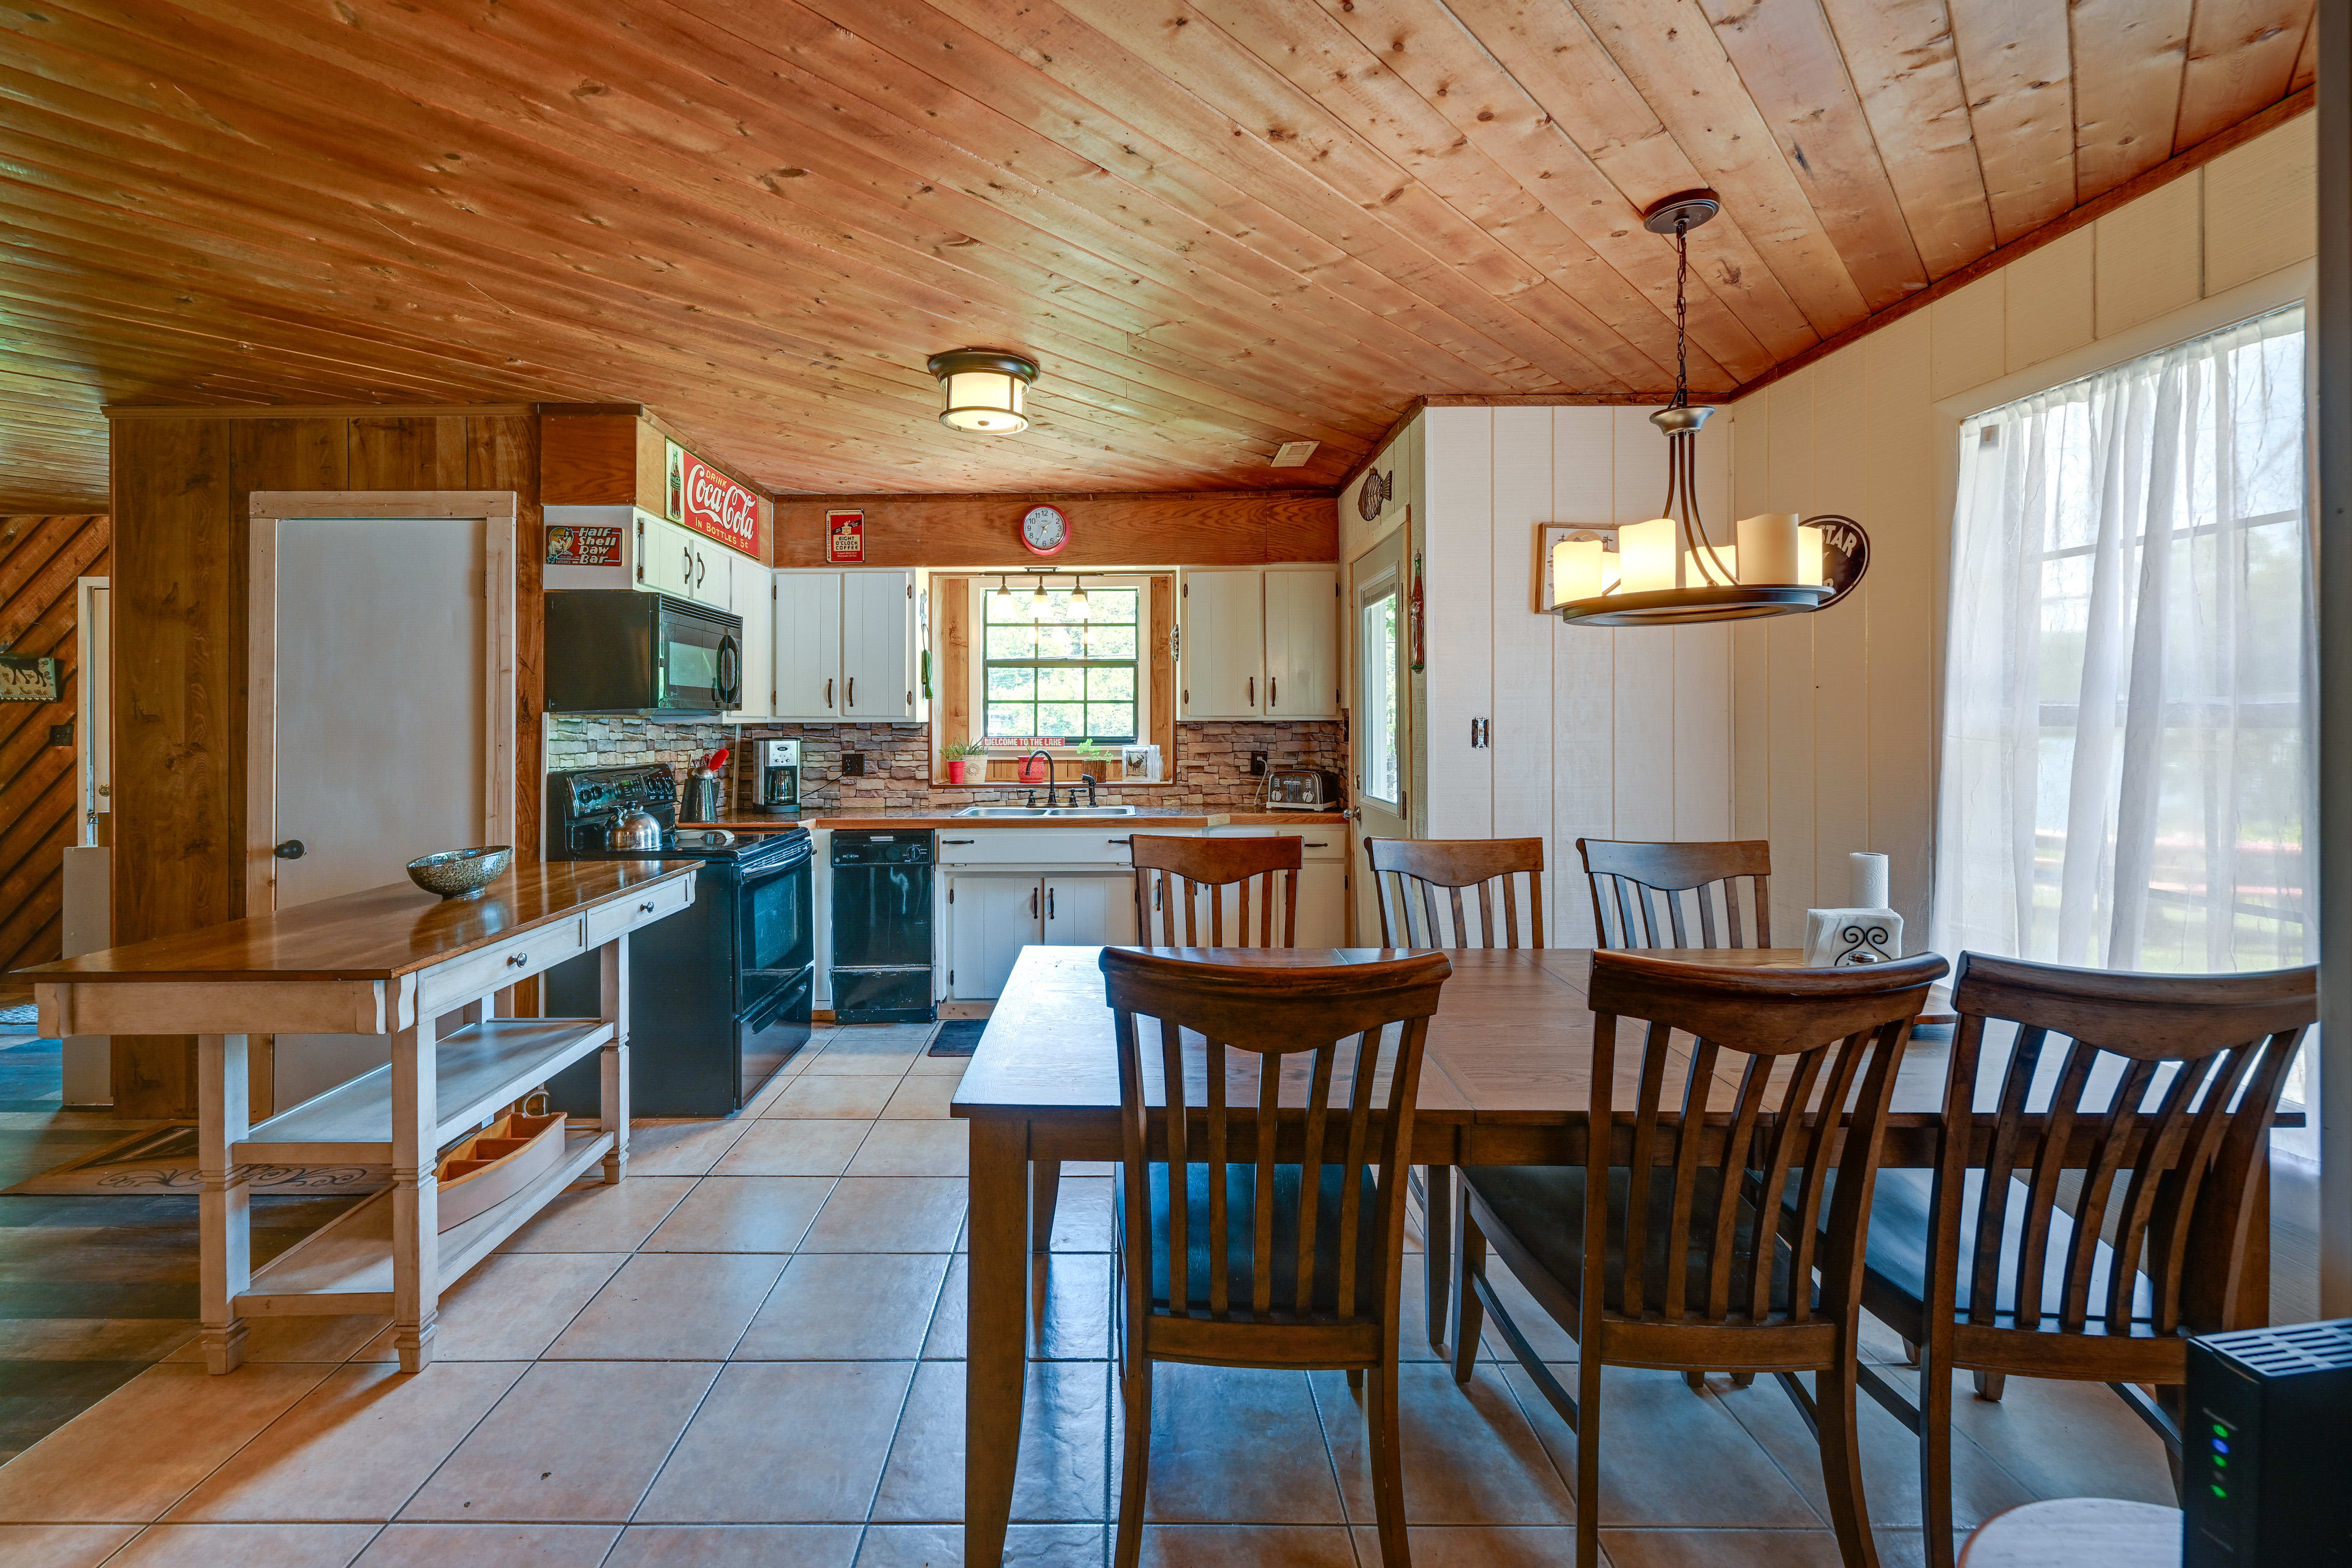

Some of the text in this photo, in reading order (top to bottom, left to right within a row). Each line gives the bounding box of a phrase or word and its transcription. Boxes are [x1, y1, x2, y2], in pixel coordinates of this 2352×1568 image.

[706, 470, 728, 489] DRINK
[687, 464, 756, 540] Coca-Cola
[578, 527, 611, 537] Half
[695, 516, 748, 549] IN BOTTLES 5¢
[578, 537, 616, 546] Shell
[578, 545, 609, 554] Raw
[579, 554, 609, 564] Bar
